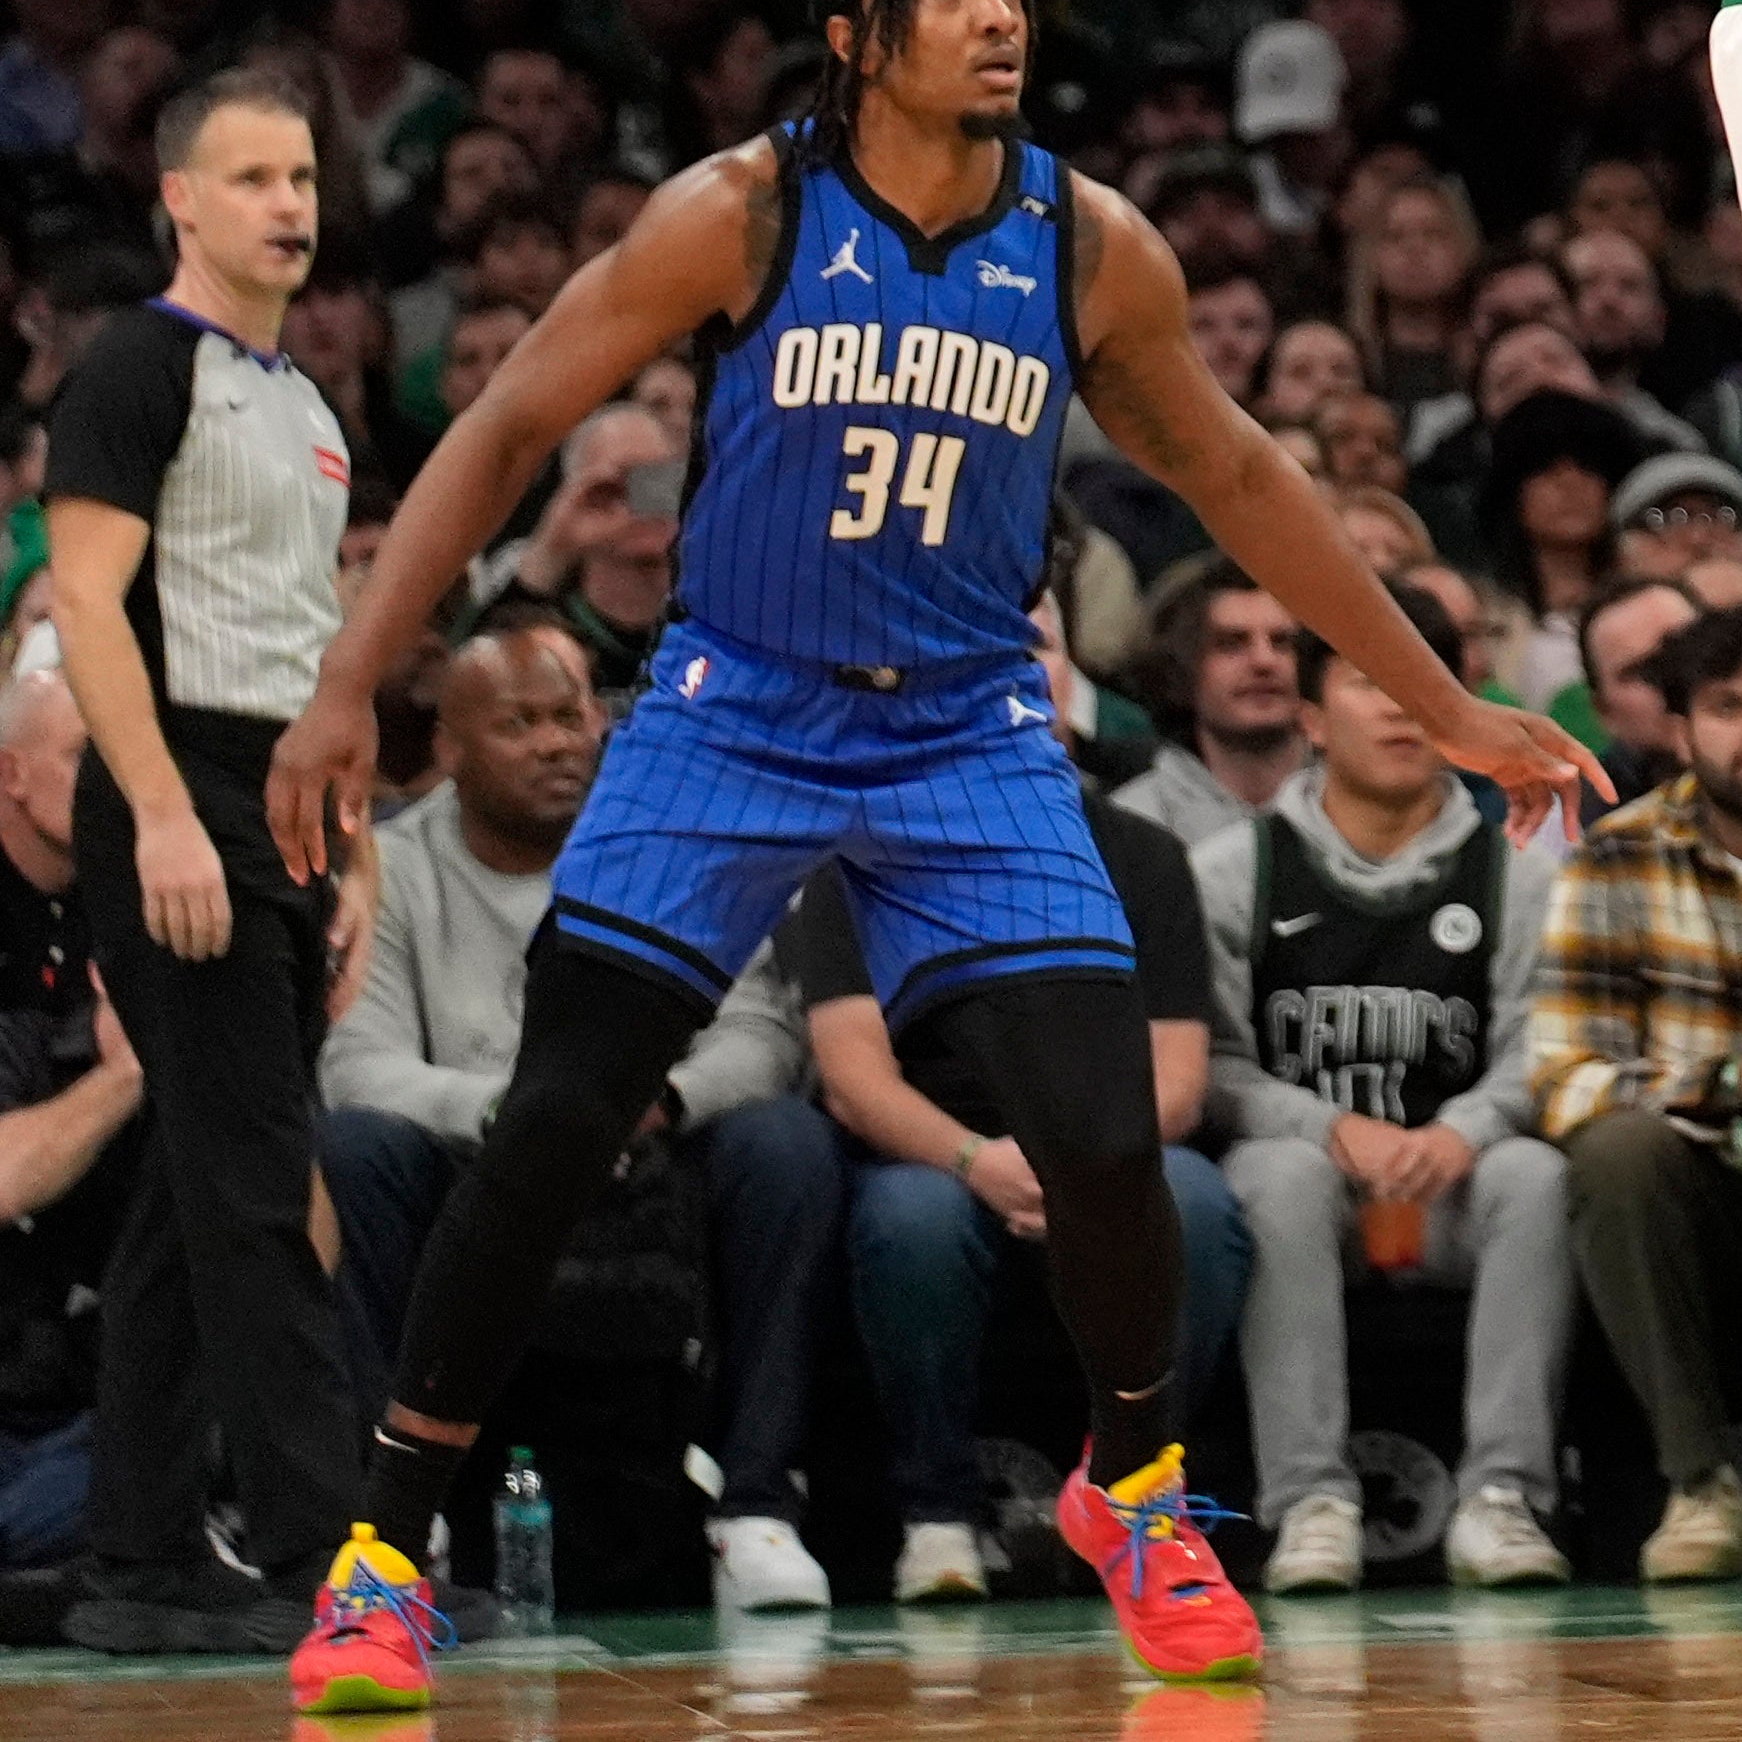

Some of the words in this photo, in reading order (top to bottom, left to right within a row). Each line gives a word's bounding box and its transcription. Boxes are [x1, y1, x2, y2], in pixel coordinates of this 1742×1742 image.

[976, 259, 1038, 298] Disney
[772, 323, 1051, 439] ORLANDO
[828, 426, 967, 548] 34
